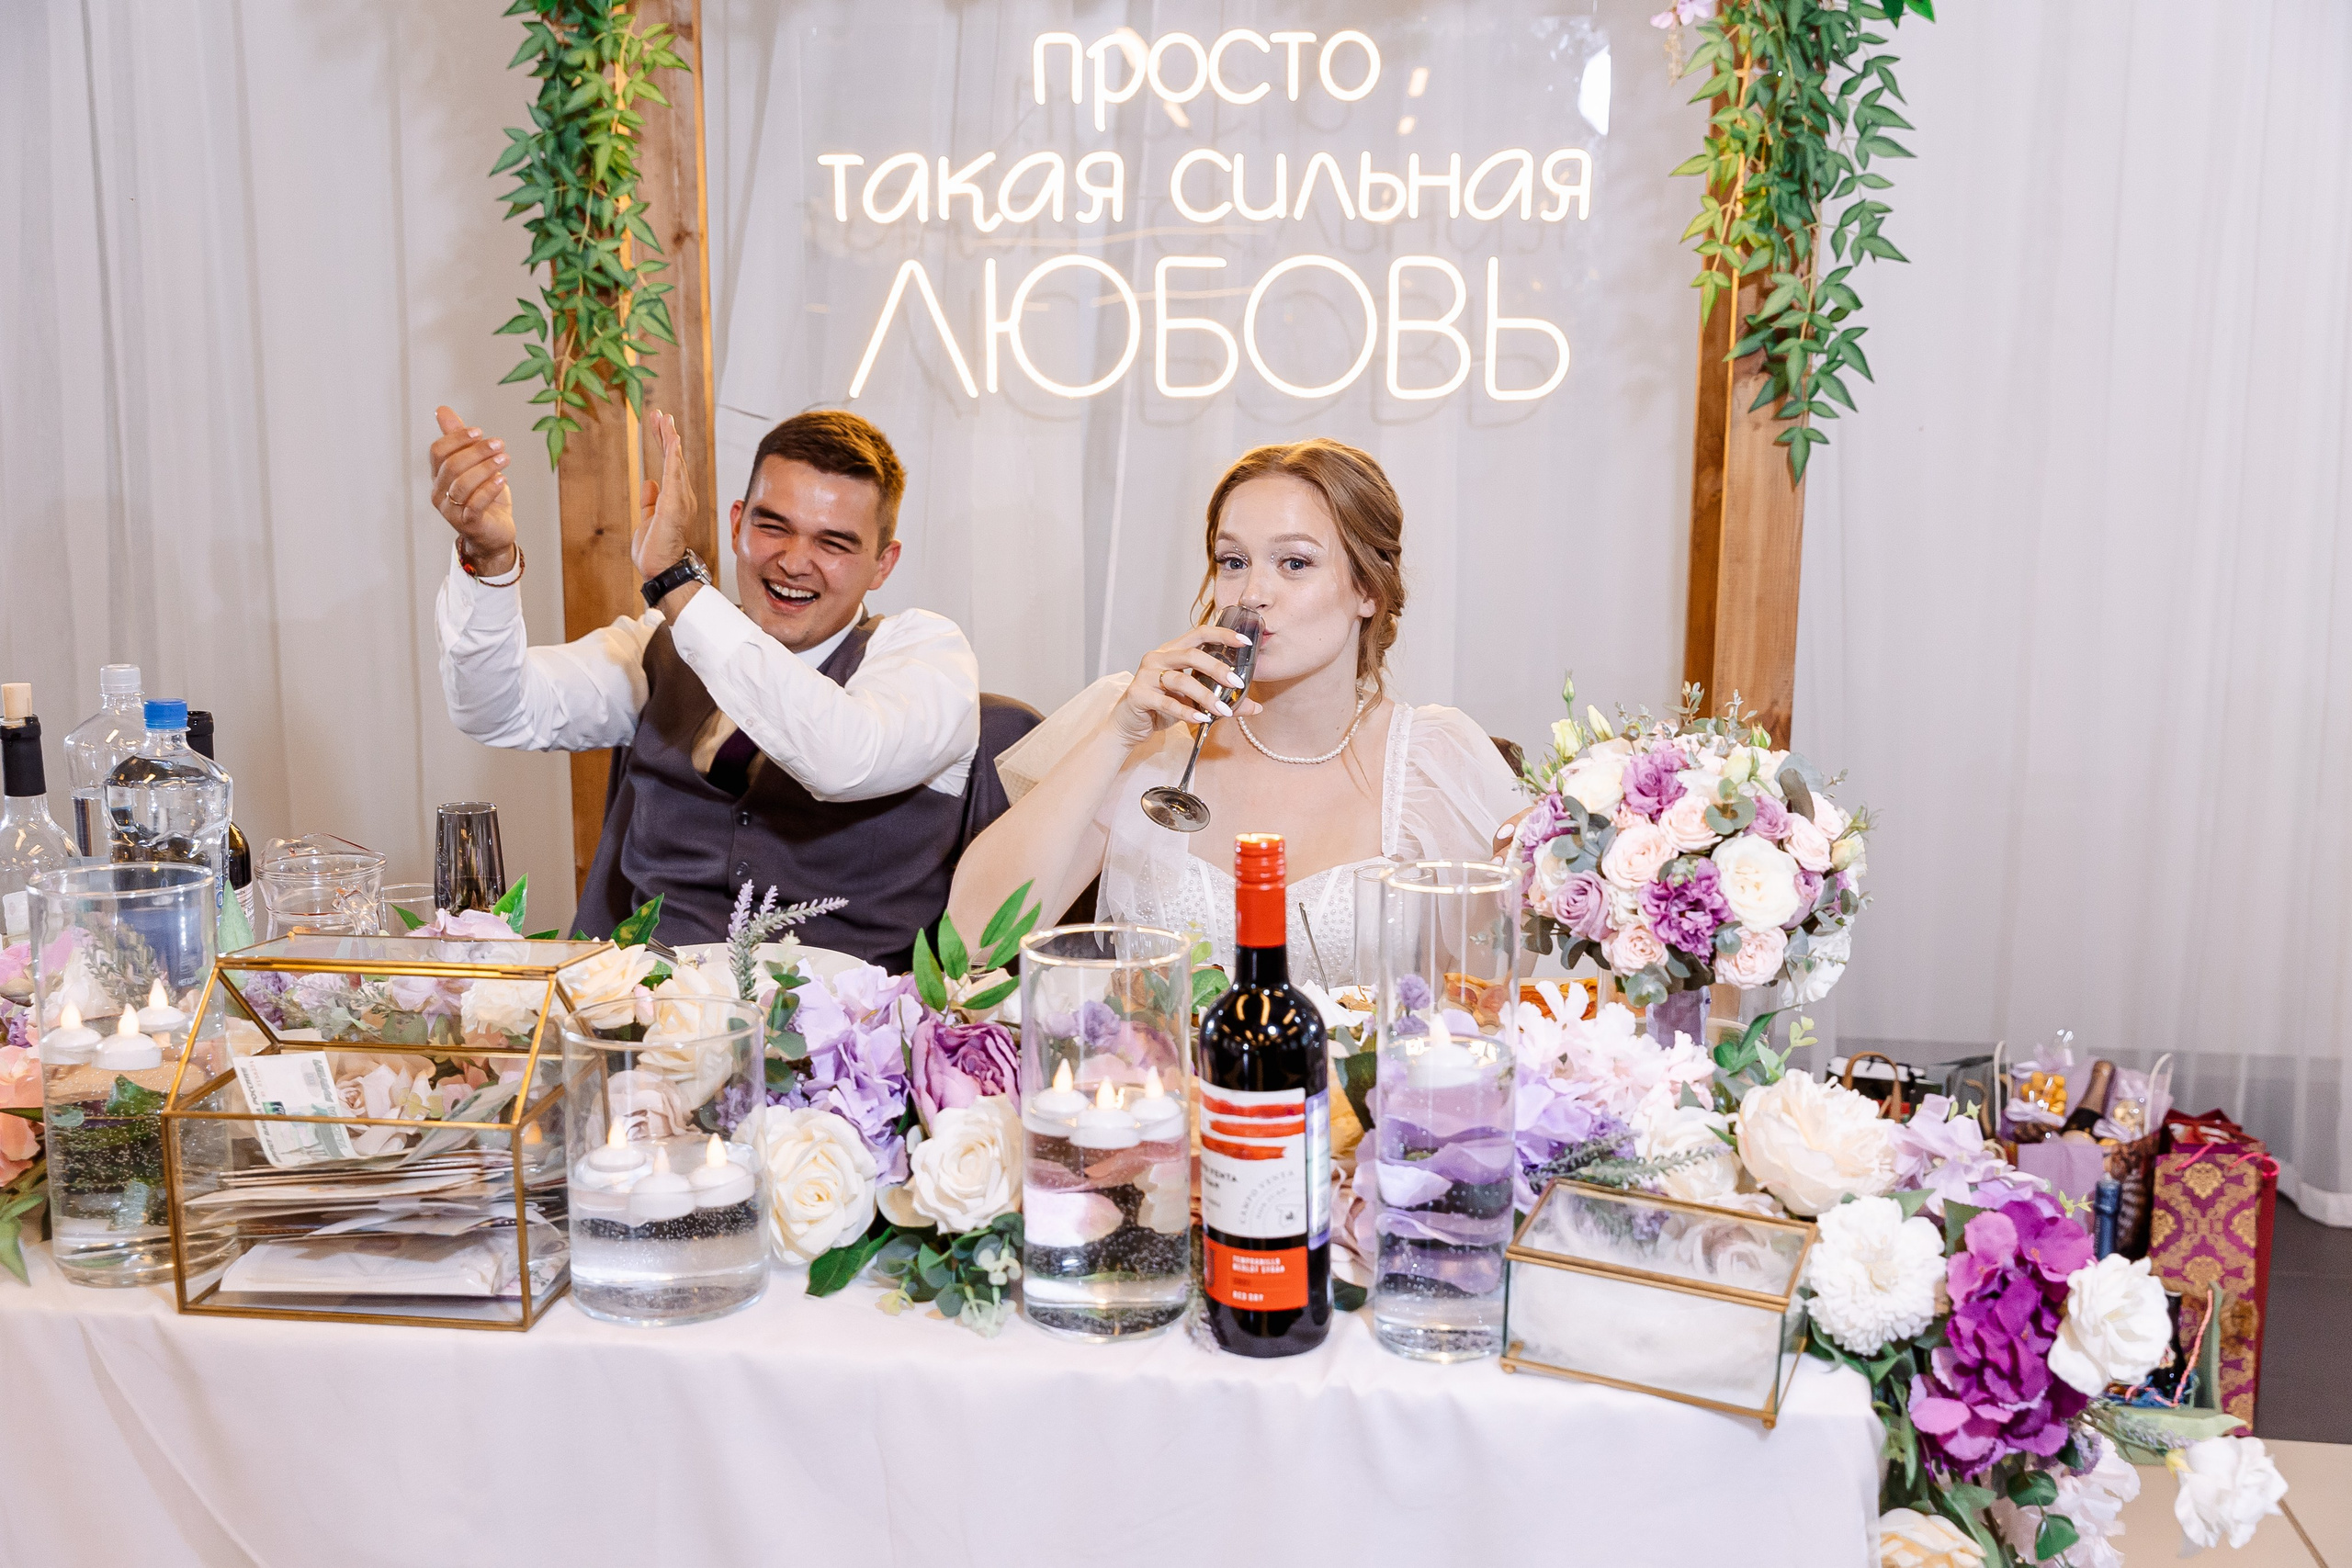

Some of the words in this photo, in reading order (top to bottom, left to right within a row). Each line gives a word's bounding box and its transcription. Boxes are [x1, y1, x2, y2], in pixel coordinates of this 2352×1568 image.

[1033, 28, 1381, 132] просто
[817, 151, 1125, 233] такая
[1170, 148, 1592, 223] сильная
[849, 254, 1571, 400] ЛЮБОВЬ
